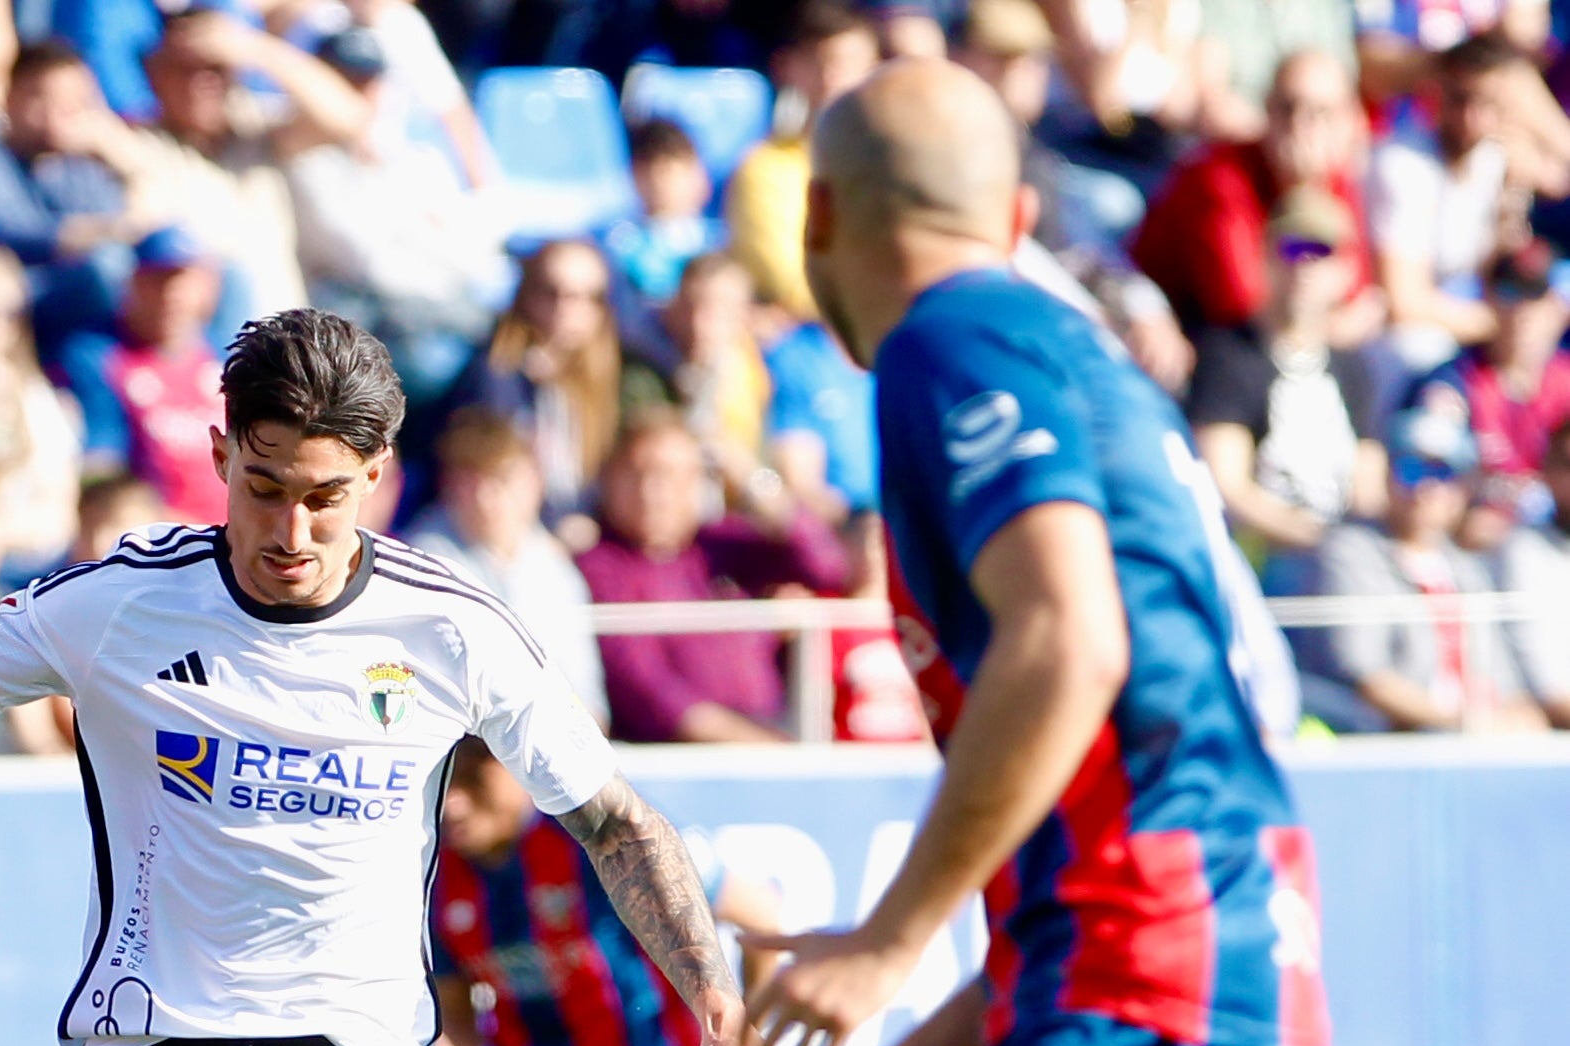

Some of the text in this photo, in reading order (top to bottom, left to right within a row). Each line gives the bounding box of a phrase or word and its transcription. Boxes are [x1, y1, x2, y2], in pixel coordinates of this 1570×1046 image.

[233, 741, 416, 791] REALE
[229, 785, 405, 820] SEGUROS
[127, 824, 160, 972] RENACIMIENTO
[111, 906, 141, 967] Burgos
